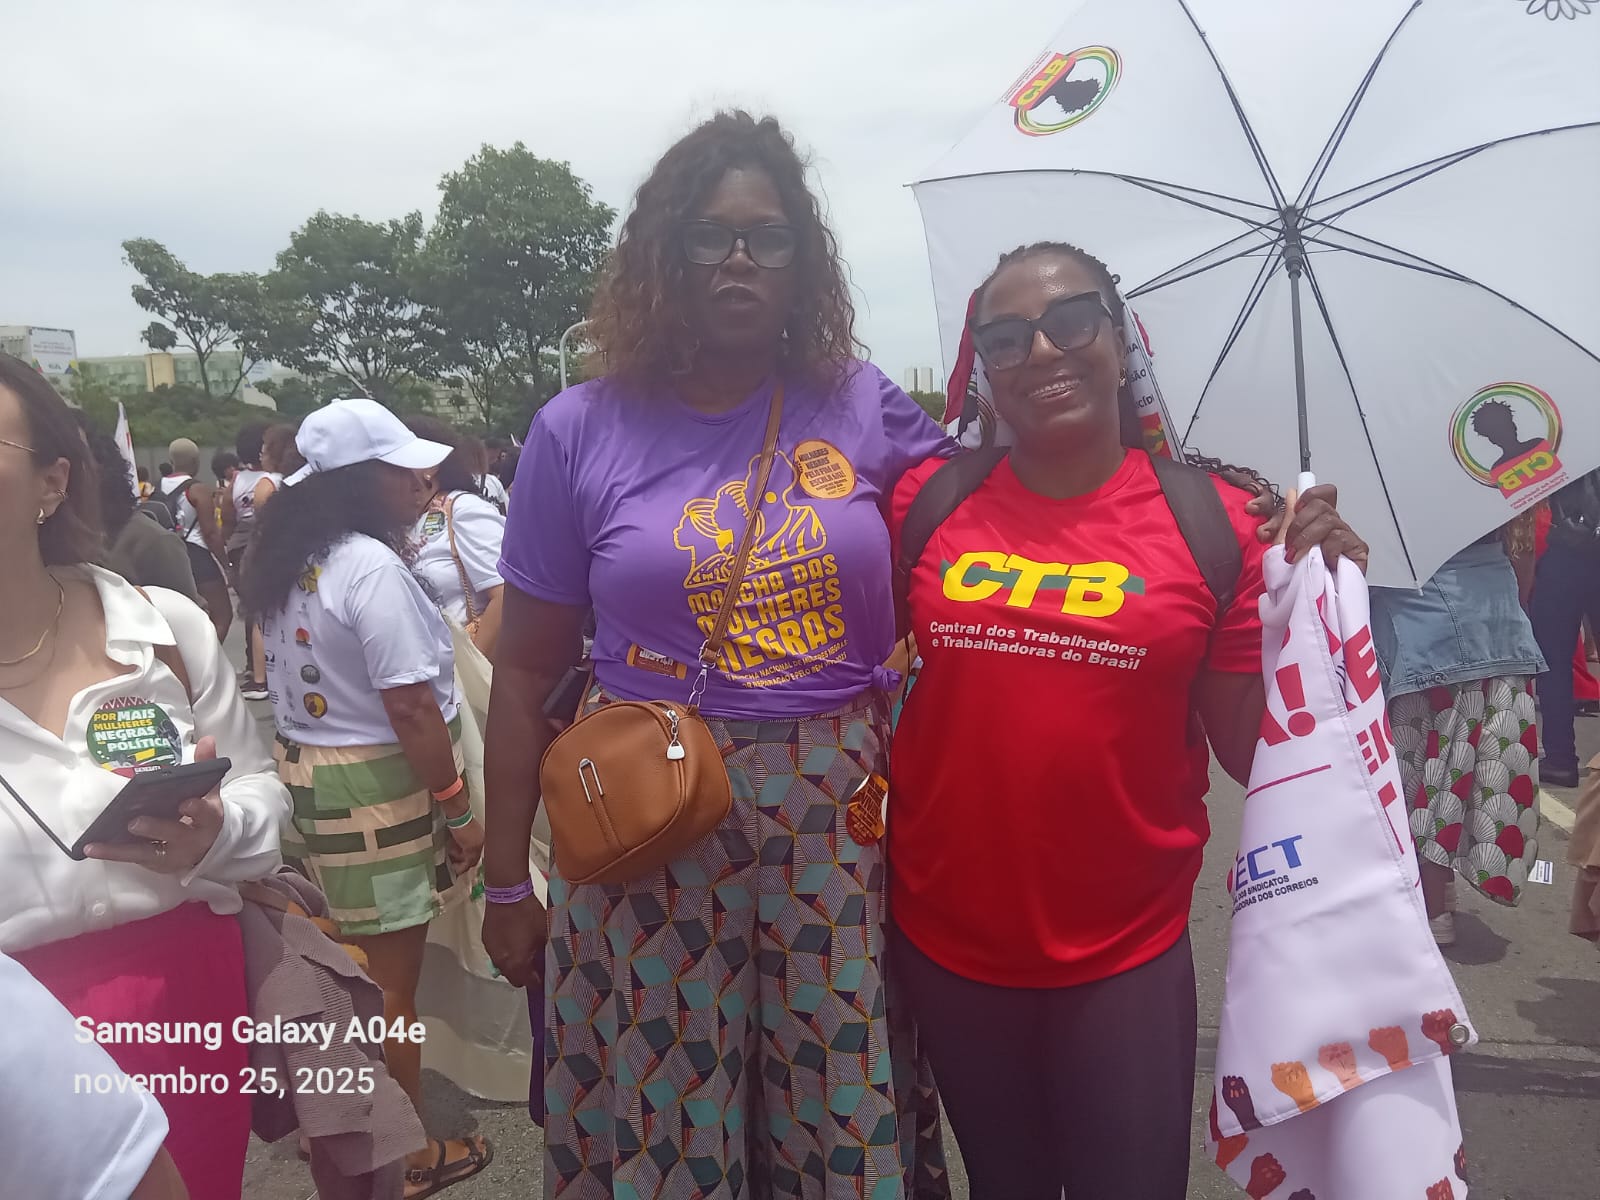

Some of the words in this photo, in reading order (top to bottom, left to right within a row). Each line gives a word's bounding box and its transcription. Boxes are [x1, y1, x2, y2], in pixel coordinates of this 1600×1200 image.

[688, 571, 785, 615] MACHA
[791, 553, 839, 585] DAS
[942, 551, 1130, 618] CTB
[929, 621, 982, 636] Central
[986, 625, 1016, 639] dos
[1023, 628, 1148, 657] Trabalhadores
[931, 638, 939, 648] e
[942, 635, 1056, 658] Trabalhadoras
[1061, 649, 1083, 662] do
[1088, 652, 1140, 671] Brasil
[93, 713, 116, 722] POR
[117, 708, 156, 722] MAIS
[93, 719, 153, 731] MULHERES
[95, 726, 156, 742] NEGRAS
[107, 738, 171, 753] POLÍTICA
[1246, 874, 1290, 895] SINDICATOS
[1257, 890, 1274, 902] DOS
[1274, 876, 1319, 897] CORREIOS
